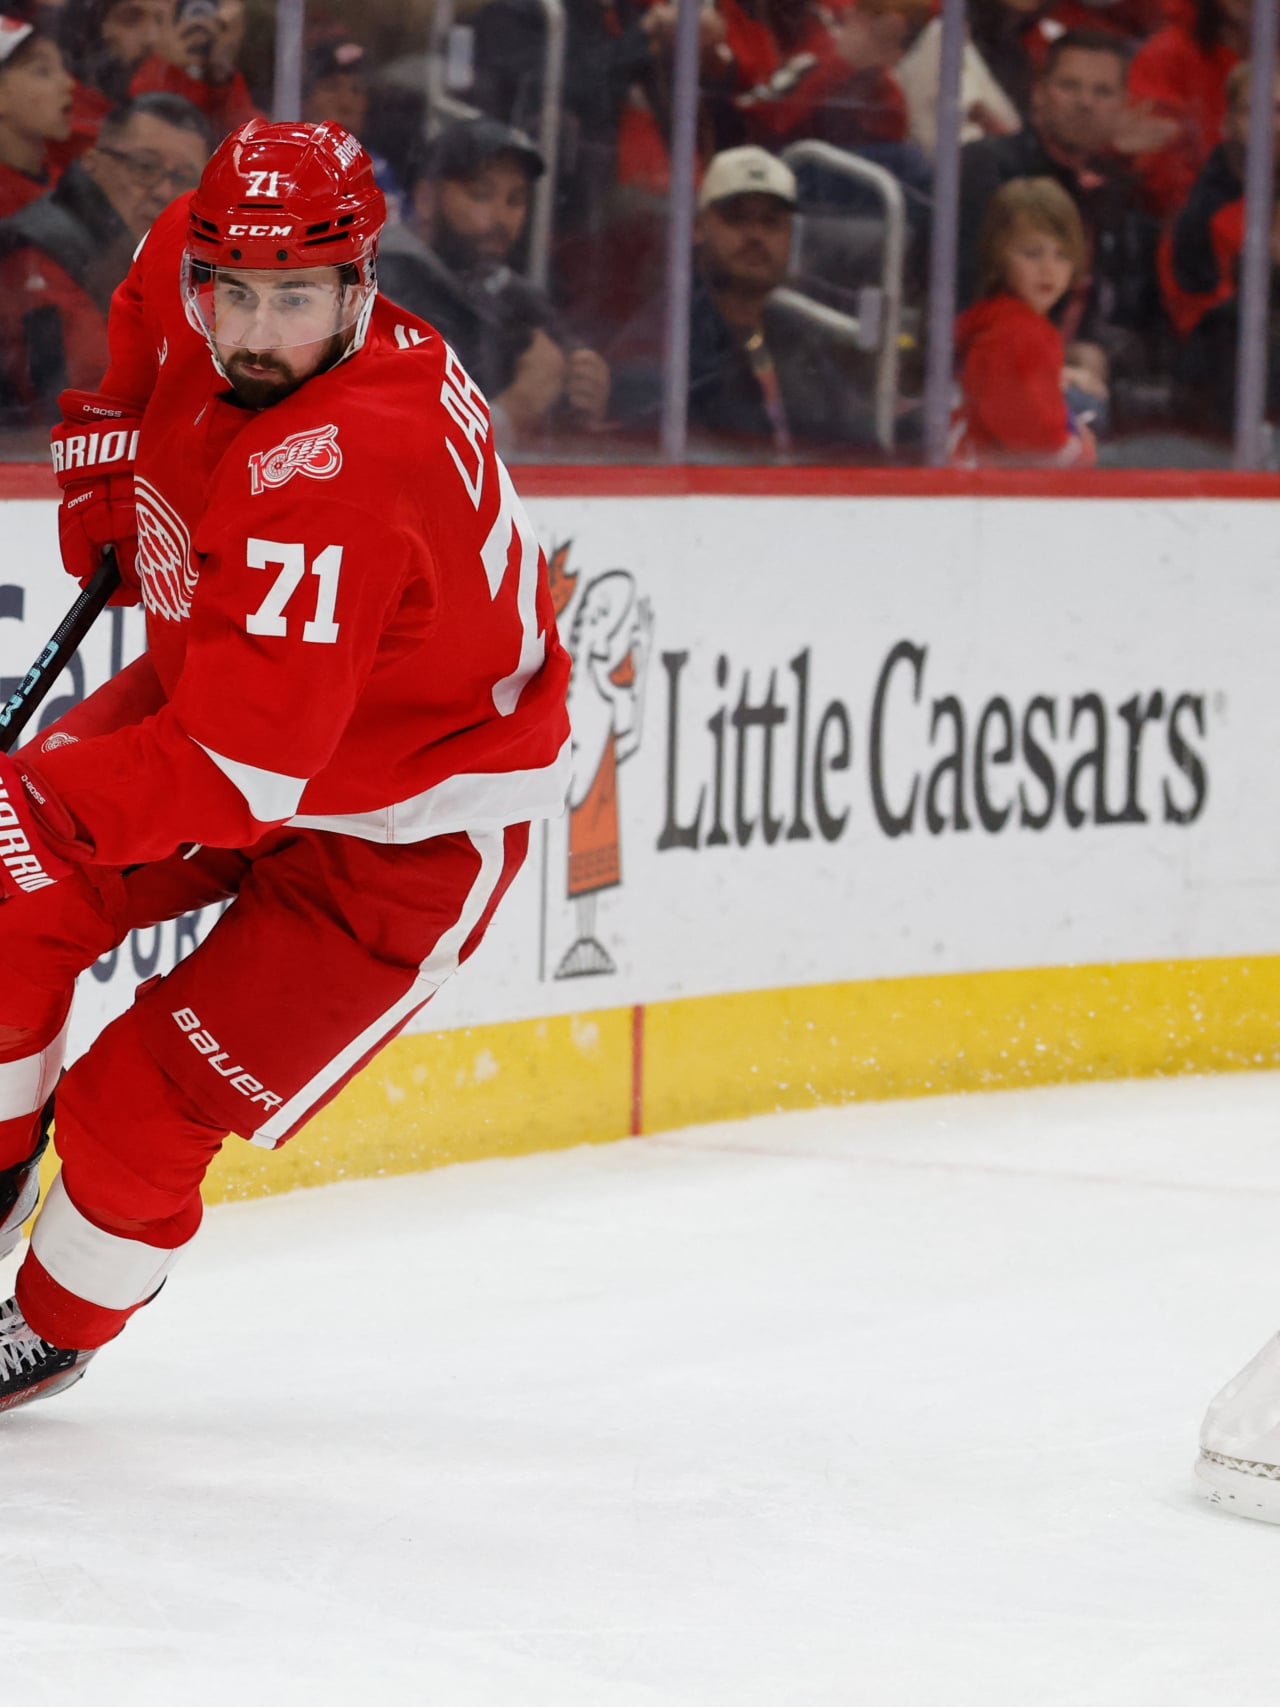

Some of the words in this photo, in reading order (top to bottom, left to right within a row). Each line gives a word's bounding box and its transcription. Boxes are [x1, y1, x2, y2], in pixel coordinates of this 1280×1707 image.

[228, 225, 293, 236] CCM
[245, 170, 279, 197] 71
[246, 537, 344, 643] 71
[656, 646, 851, 852] Little
[869, 640, 1209, 839] Caesars
[171, 1007, 284, 1111] BAUER
